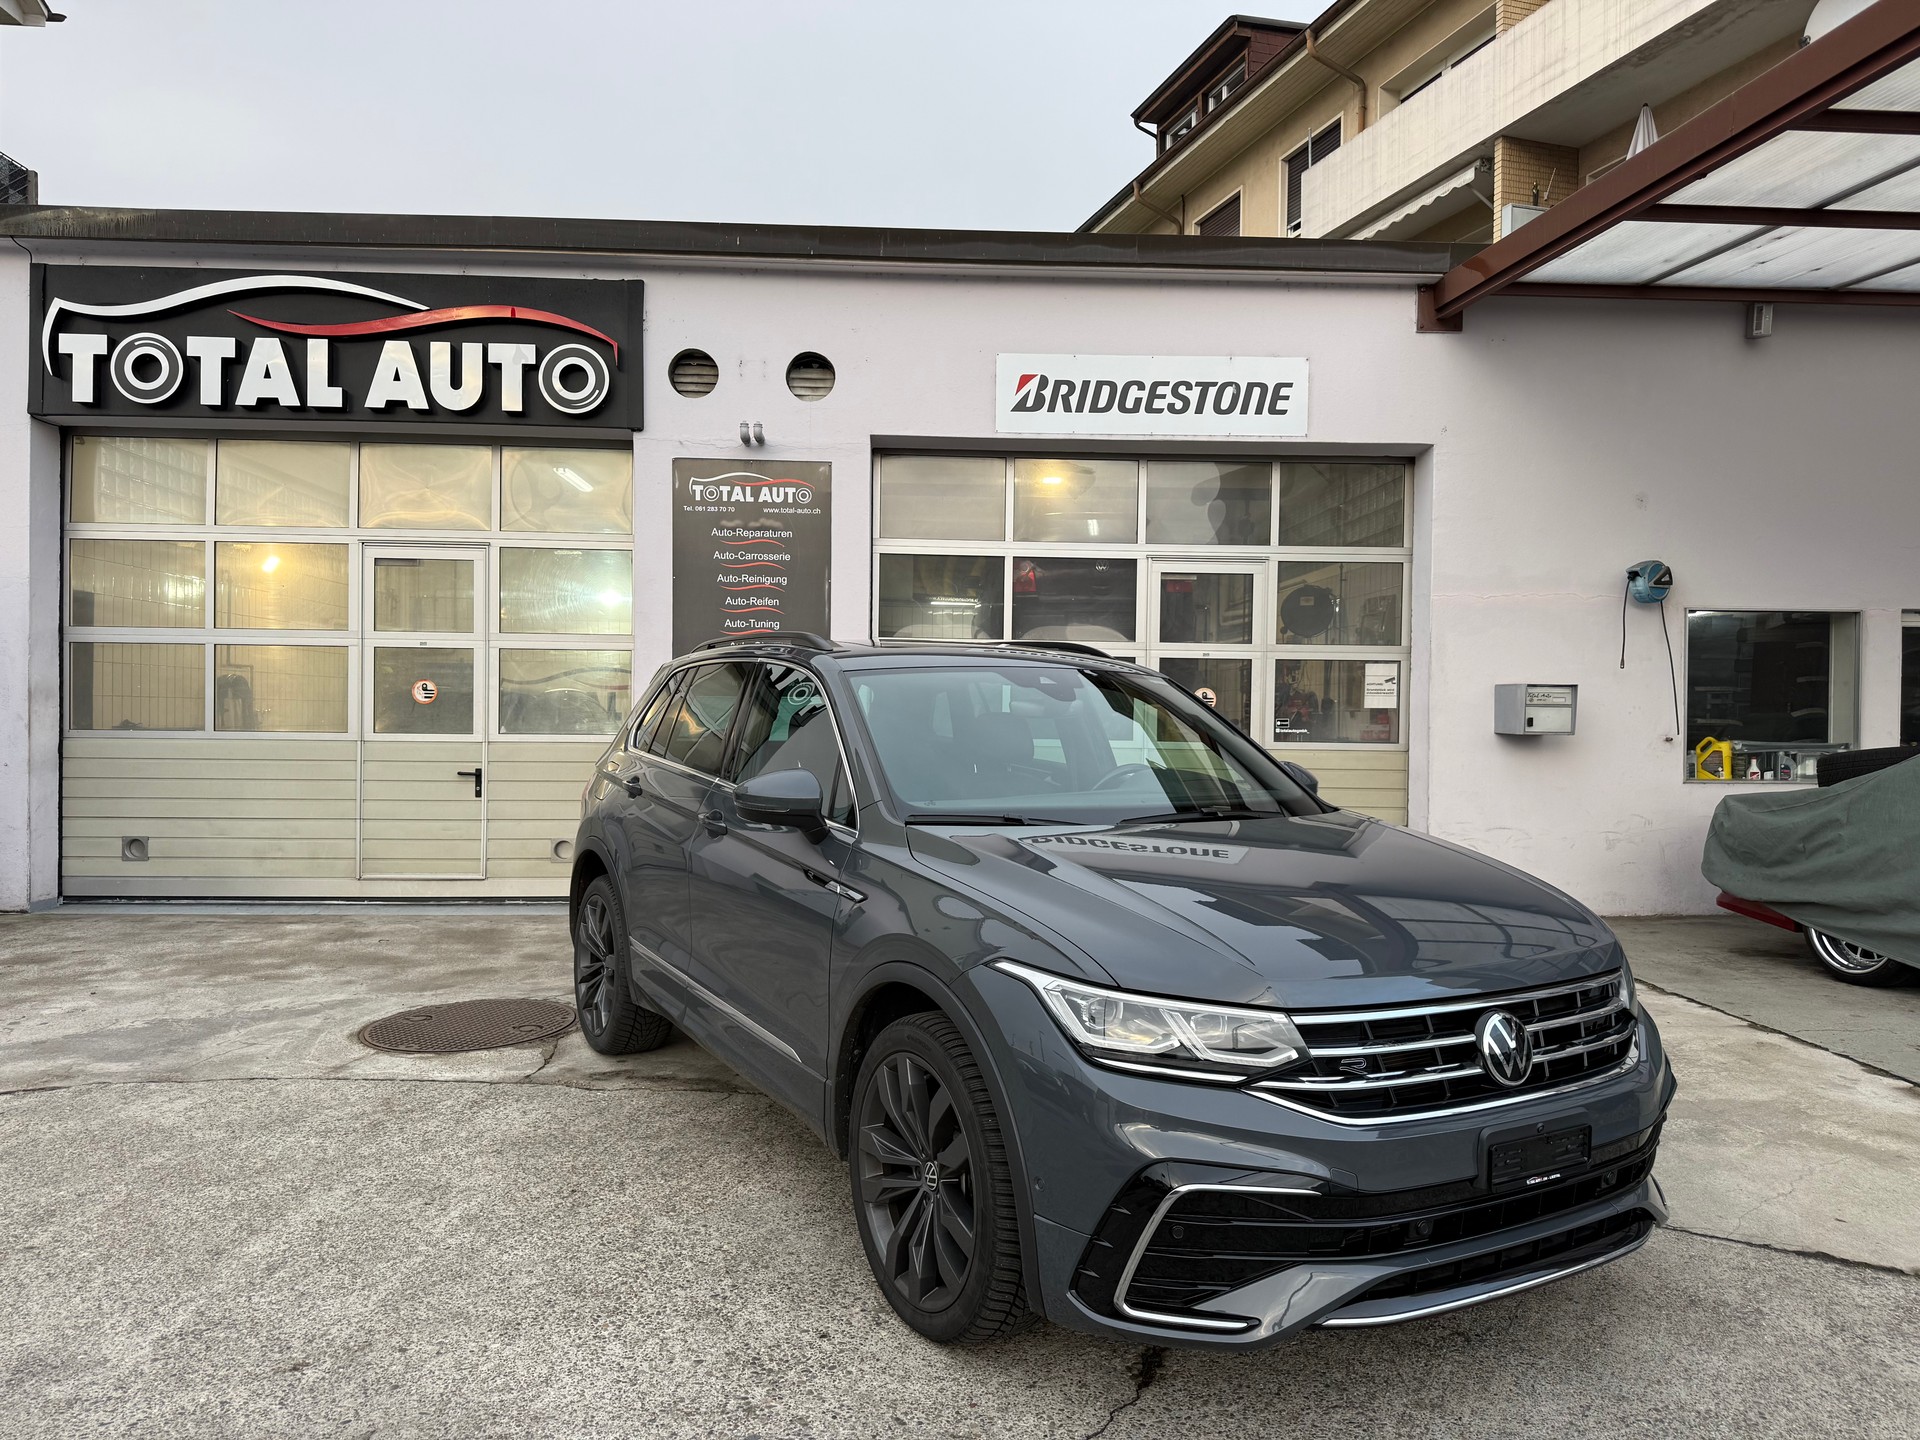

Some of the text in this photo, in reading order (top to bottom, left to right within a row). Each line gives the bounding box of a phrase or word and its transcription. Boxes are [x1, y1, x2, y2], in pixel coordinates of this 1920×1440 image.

[58, 332, 610, 415] TOTAL AUTO
[1010, 373, 1294, 416] BRIDGESTONE
[692, 485, 813, 505] TOTAL AUTO
[762, 507, 821, 515] www.total-auto.ch
[711, 527, 793, 539] Auto-Reparaturen
[713, 550, 791, 561] Auto-Carrosserie
[716, 573, 788, 586] Auto-Reinigung
[725, 596, 780, 606] Auto-Reifen
[724, 618, 780, 630] Auto-Tuning
